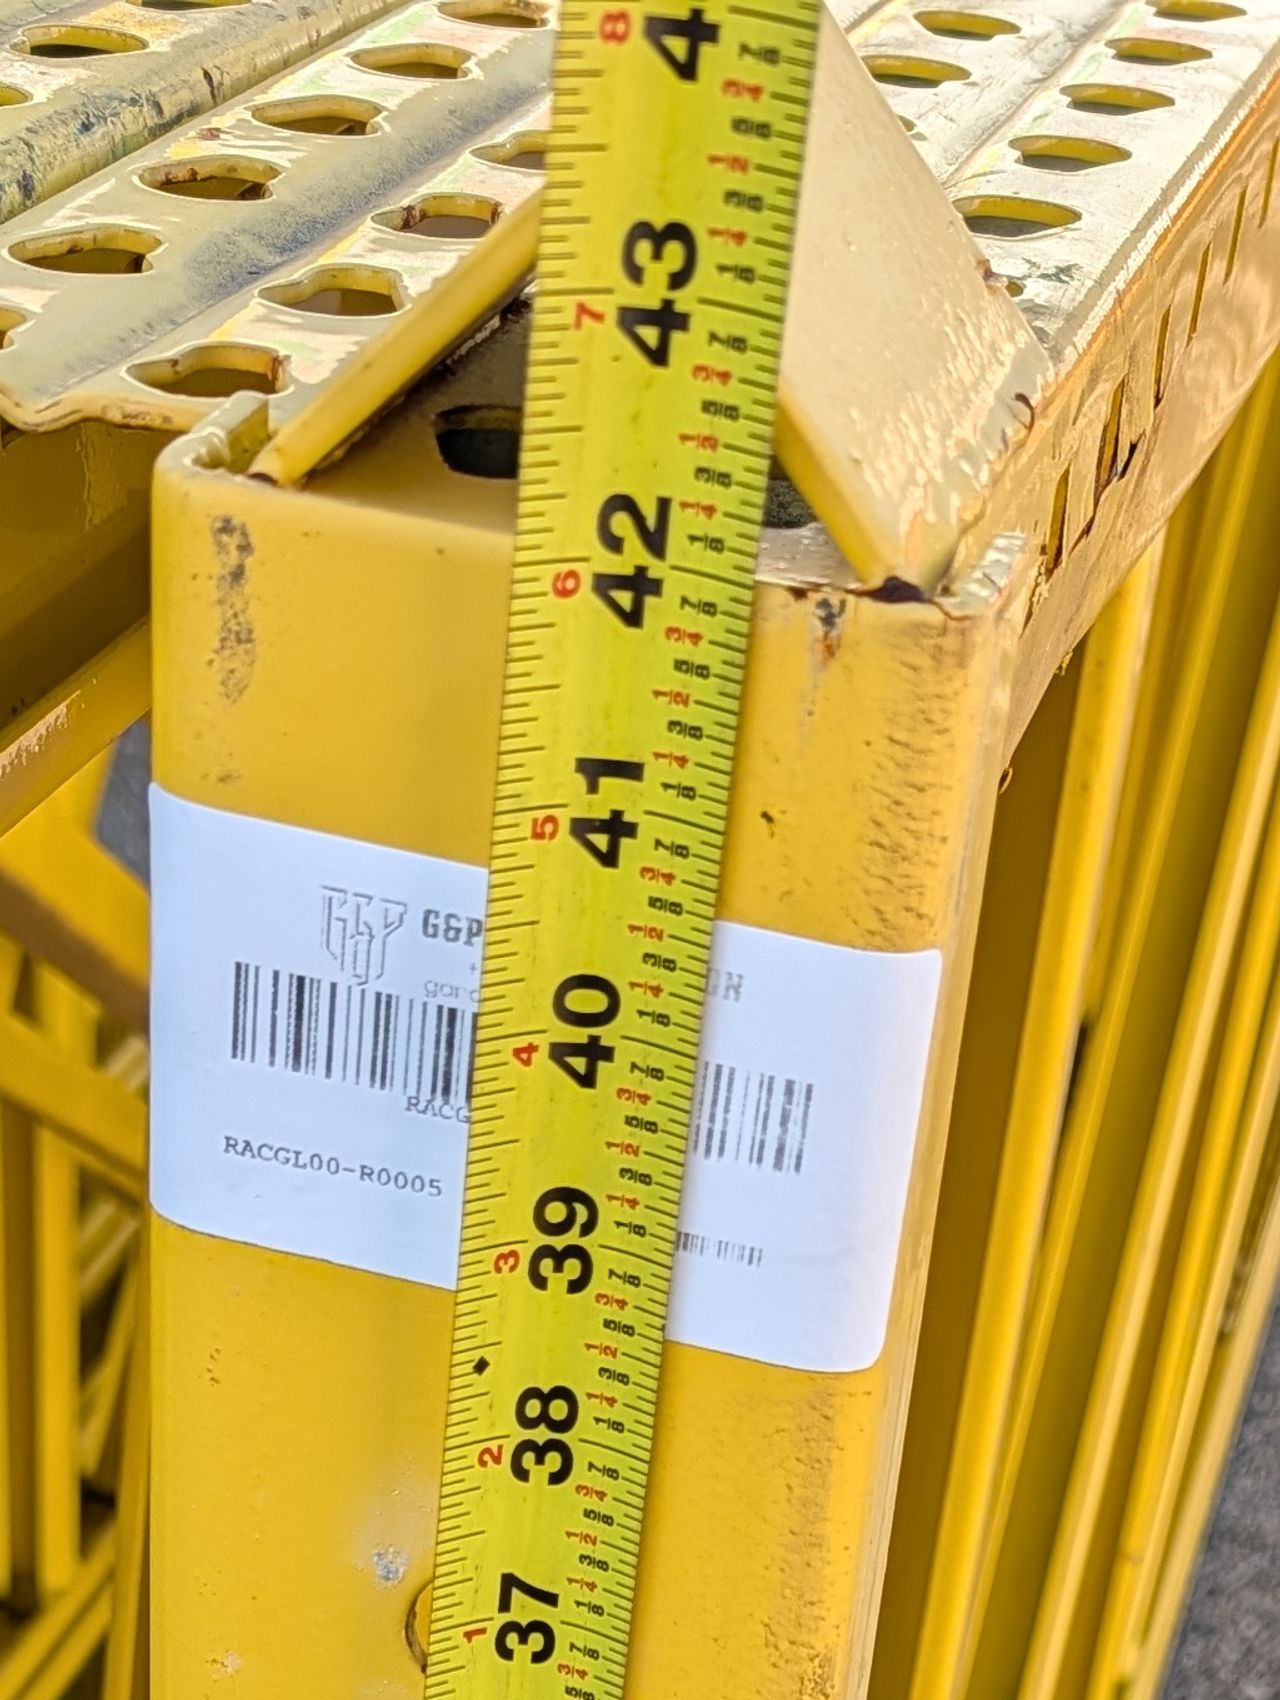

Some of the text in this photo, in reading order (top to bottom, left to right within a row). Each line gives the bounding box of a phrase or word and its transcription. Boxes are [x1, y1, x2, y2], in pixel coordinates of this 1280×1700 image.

[574, 302, 605, 330] 7
[616, 221, 697, 368] 43
[552, 569, 581, 599] 6
[592, 493, 673, 630] 42
[531, 814, 559, 841] 5
[569, 757, 645, 869] 41
[422, 908, 483, 947] G&P
[512, 1042, 540, 1067] 4
[548, 973, 621, 1089] 40
[223, 1135, 443, 1198] RACGL00-R0005
[493, 1249, 521, 1274] 3
[528, 1186, 599, 1295] 39
[478, 1444, 504, 1468] 2
[510, 1385, 579, 1486] 38
[463, 1627, 488, 1644] 1
[494, 1572, 560, 1665] 37
